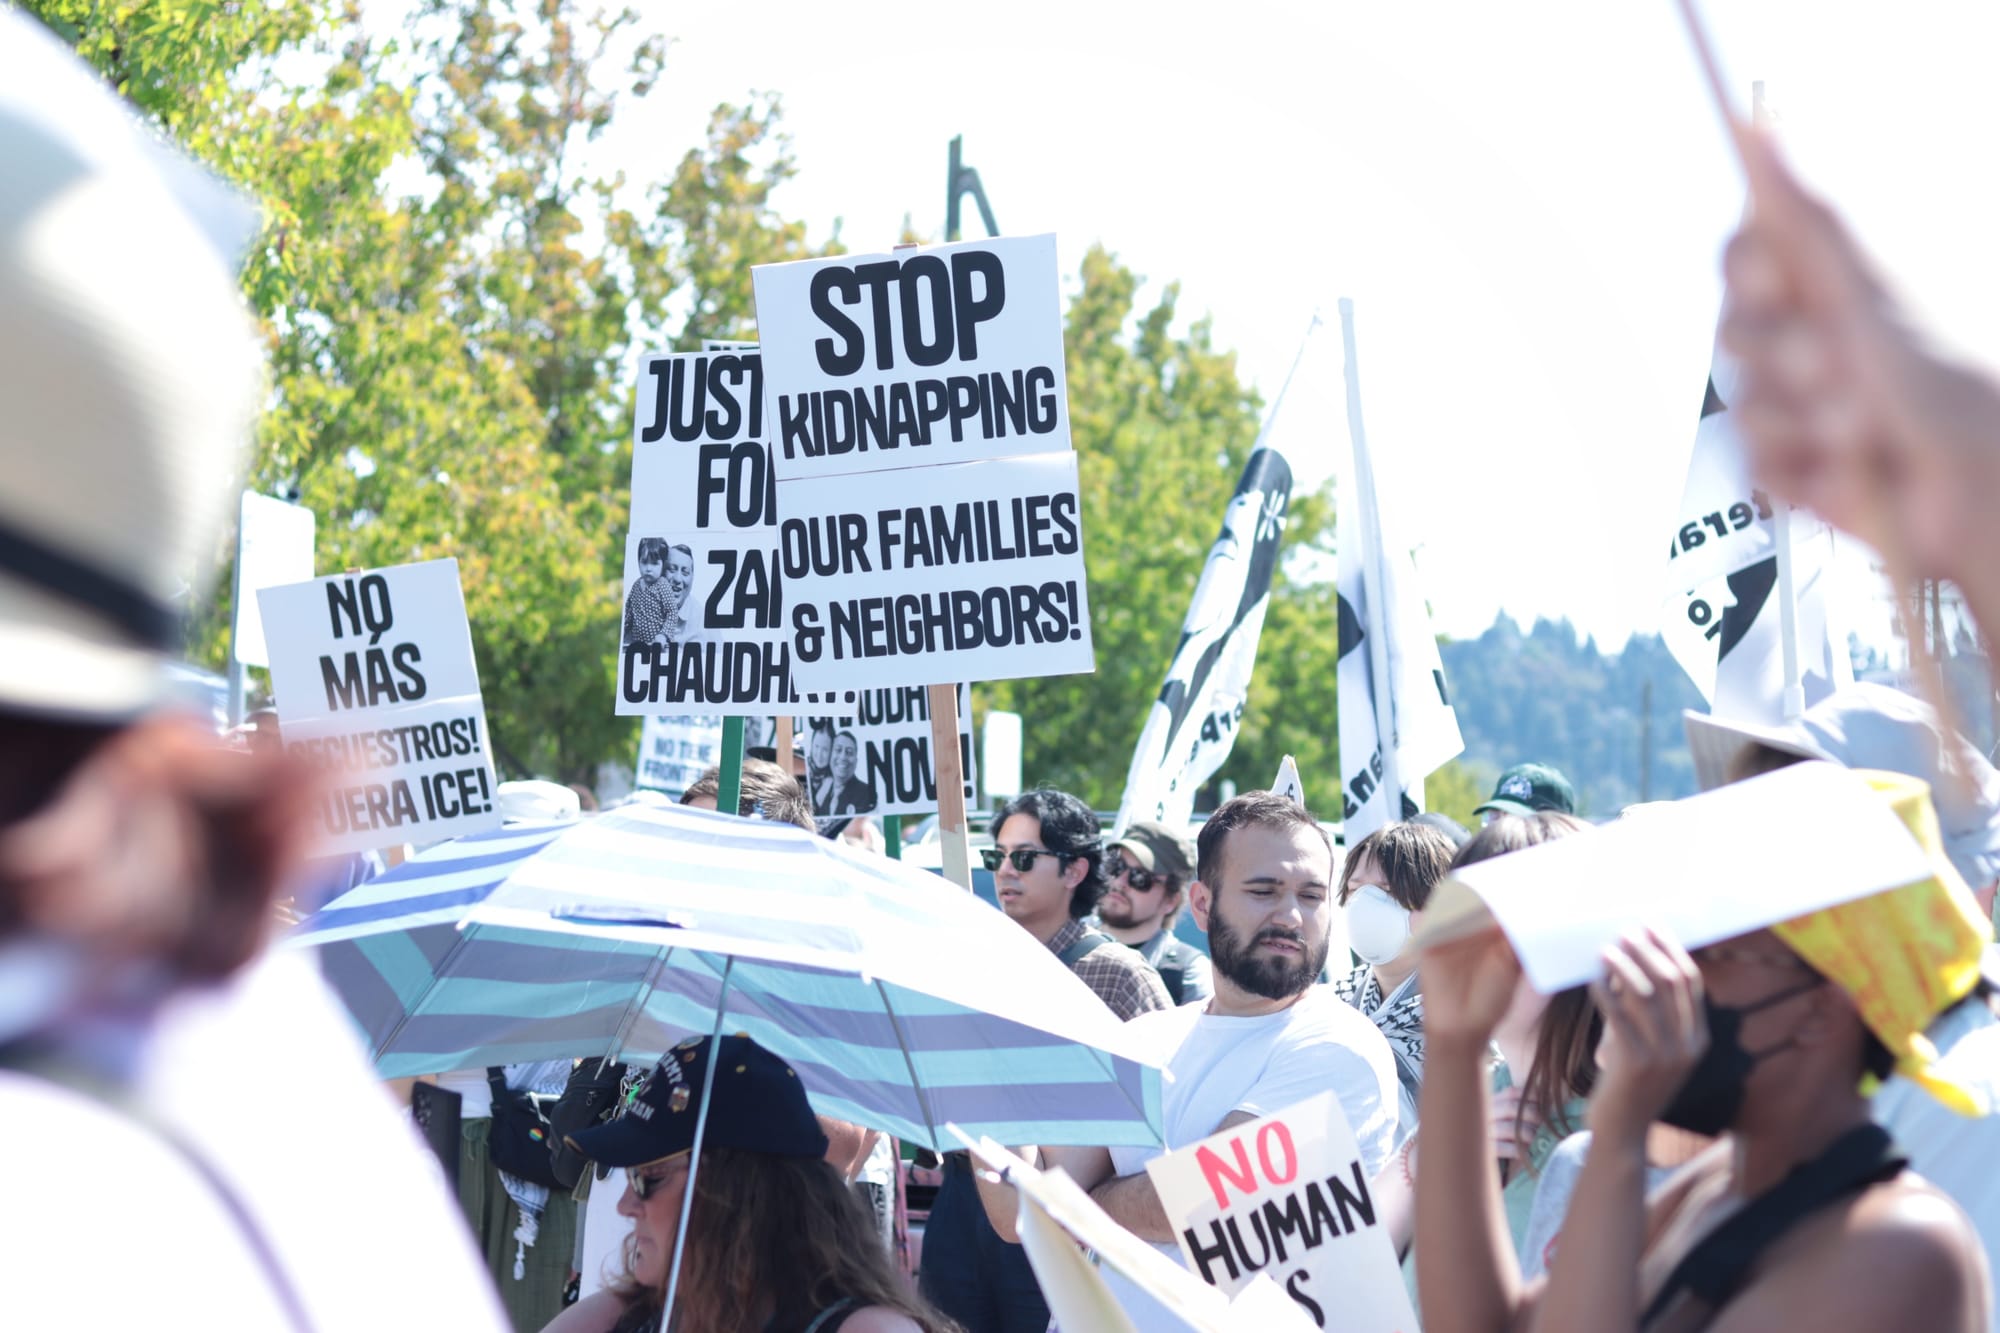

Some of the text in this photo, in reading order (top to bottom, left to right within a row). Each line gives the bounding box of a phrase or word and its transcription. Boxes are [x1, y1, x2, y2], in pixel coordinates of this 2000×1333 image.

[810, 250, 1006, 376] STOP
[779, 366, 1058, 459] KIDNAPPING
[781, 493, 1079, 580] OUR FAMILIES
[326, 574, 393, 638] NO
[792, 581, 1082, 663] & NEIGHBORS!
[319, 634, 427, 711] MÁS
[321, 767, 492, 836] UERA ICE!
[1196, 1121, 1298, 1211] NO
[1184, 1161, 1377, 1286] HUMAN
